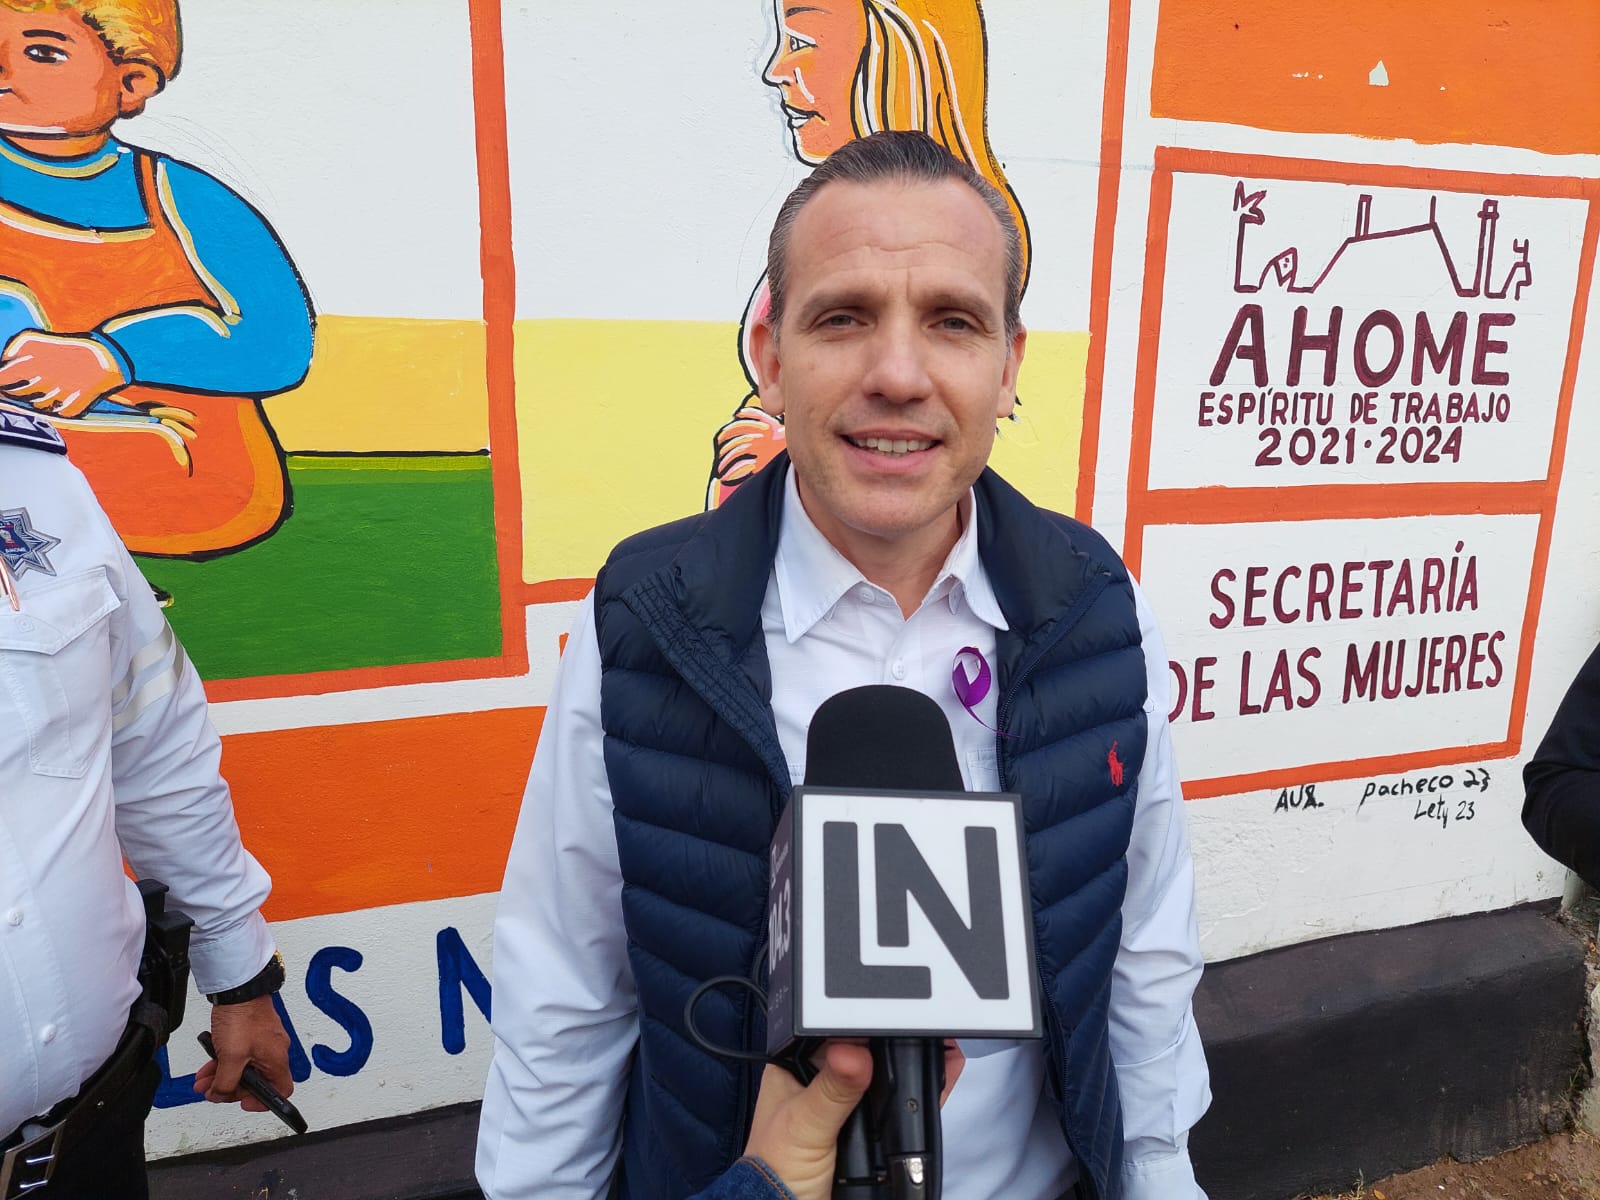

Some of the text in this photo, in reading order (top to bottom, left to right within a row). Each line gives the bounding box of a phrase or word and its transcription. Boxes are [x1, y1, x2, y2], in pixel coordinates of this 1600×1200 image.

[1209, 304, 1516, 388] AHOME
[1199, 388, 1511, 427] ESPÍRITU DE TRABAJO
[1209, 540, 1479, 630] SECRETARÍA
[1239, 647, 1322, 716] LAS
[1342, 630, 1506, 704] MUJERES
[1414, 793, 1475, 829] Lety 23
[1463, 767, 1491, 792] 23
[822, 821, 1010, 1000] LN
